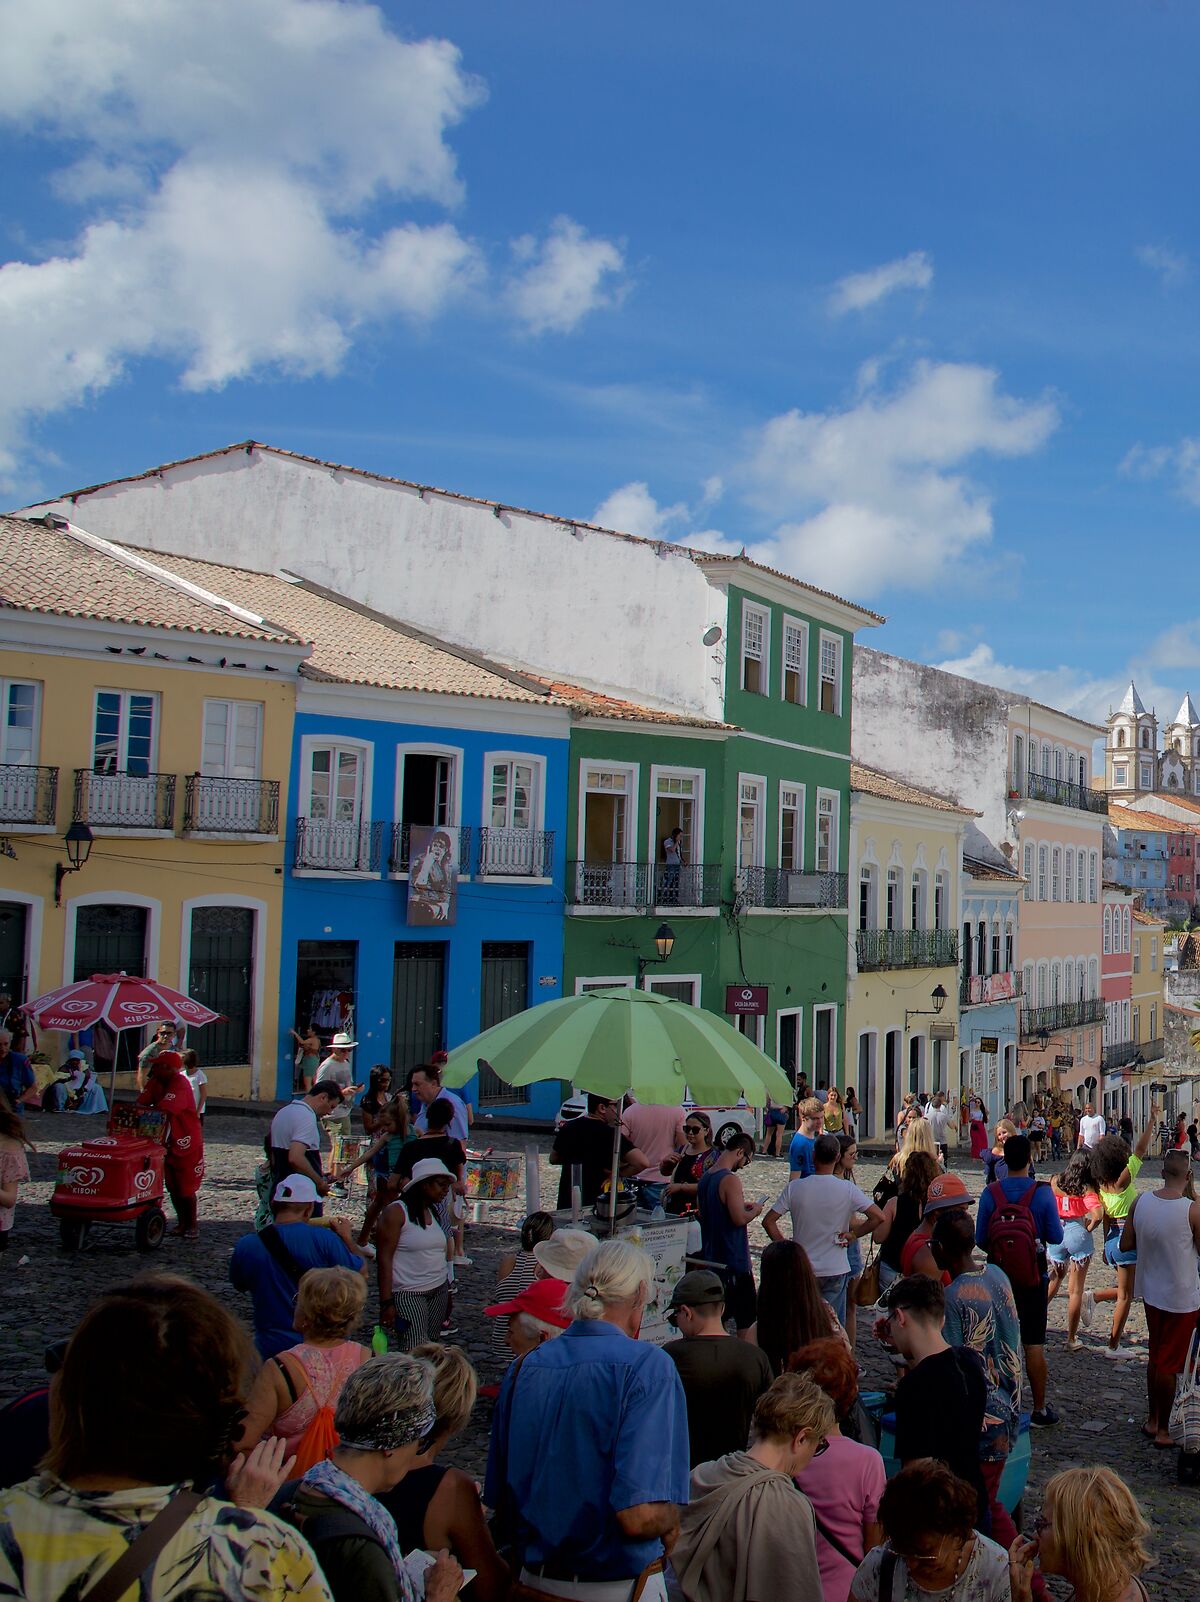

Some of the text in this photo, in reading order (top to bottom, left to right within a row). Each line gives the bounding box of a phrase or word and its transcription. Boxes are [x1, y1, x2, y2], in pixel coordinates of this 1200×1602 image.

[48, 1017, 82, 1027] KIBON
[124, 1014, 161, 1023] KIBON
[73, 1187, 97, 1195] KIBON
